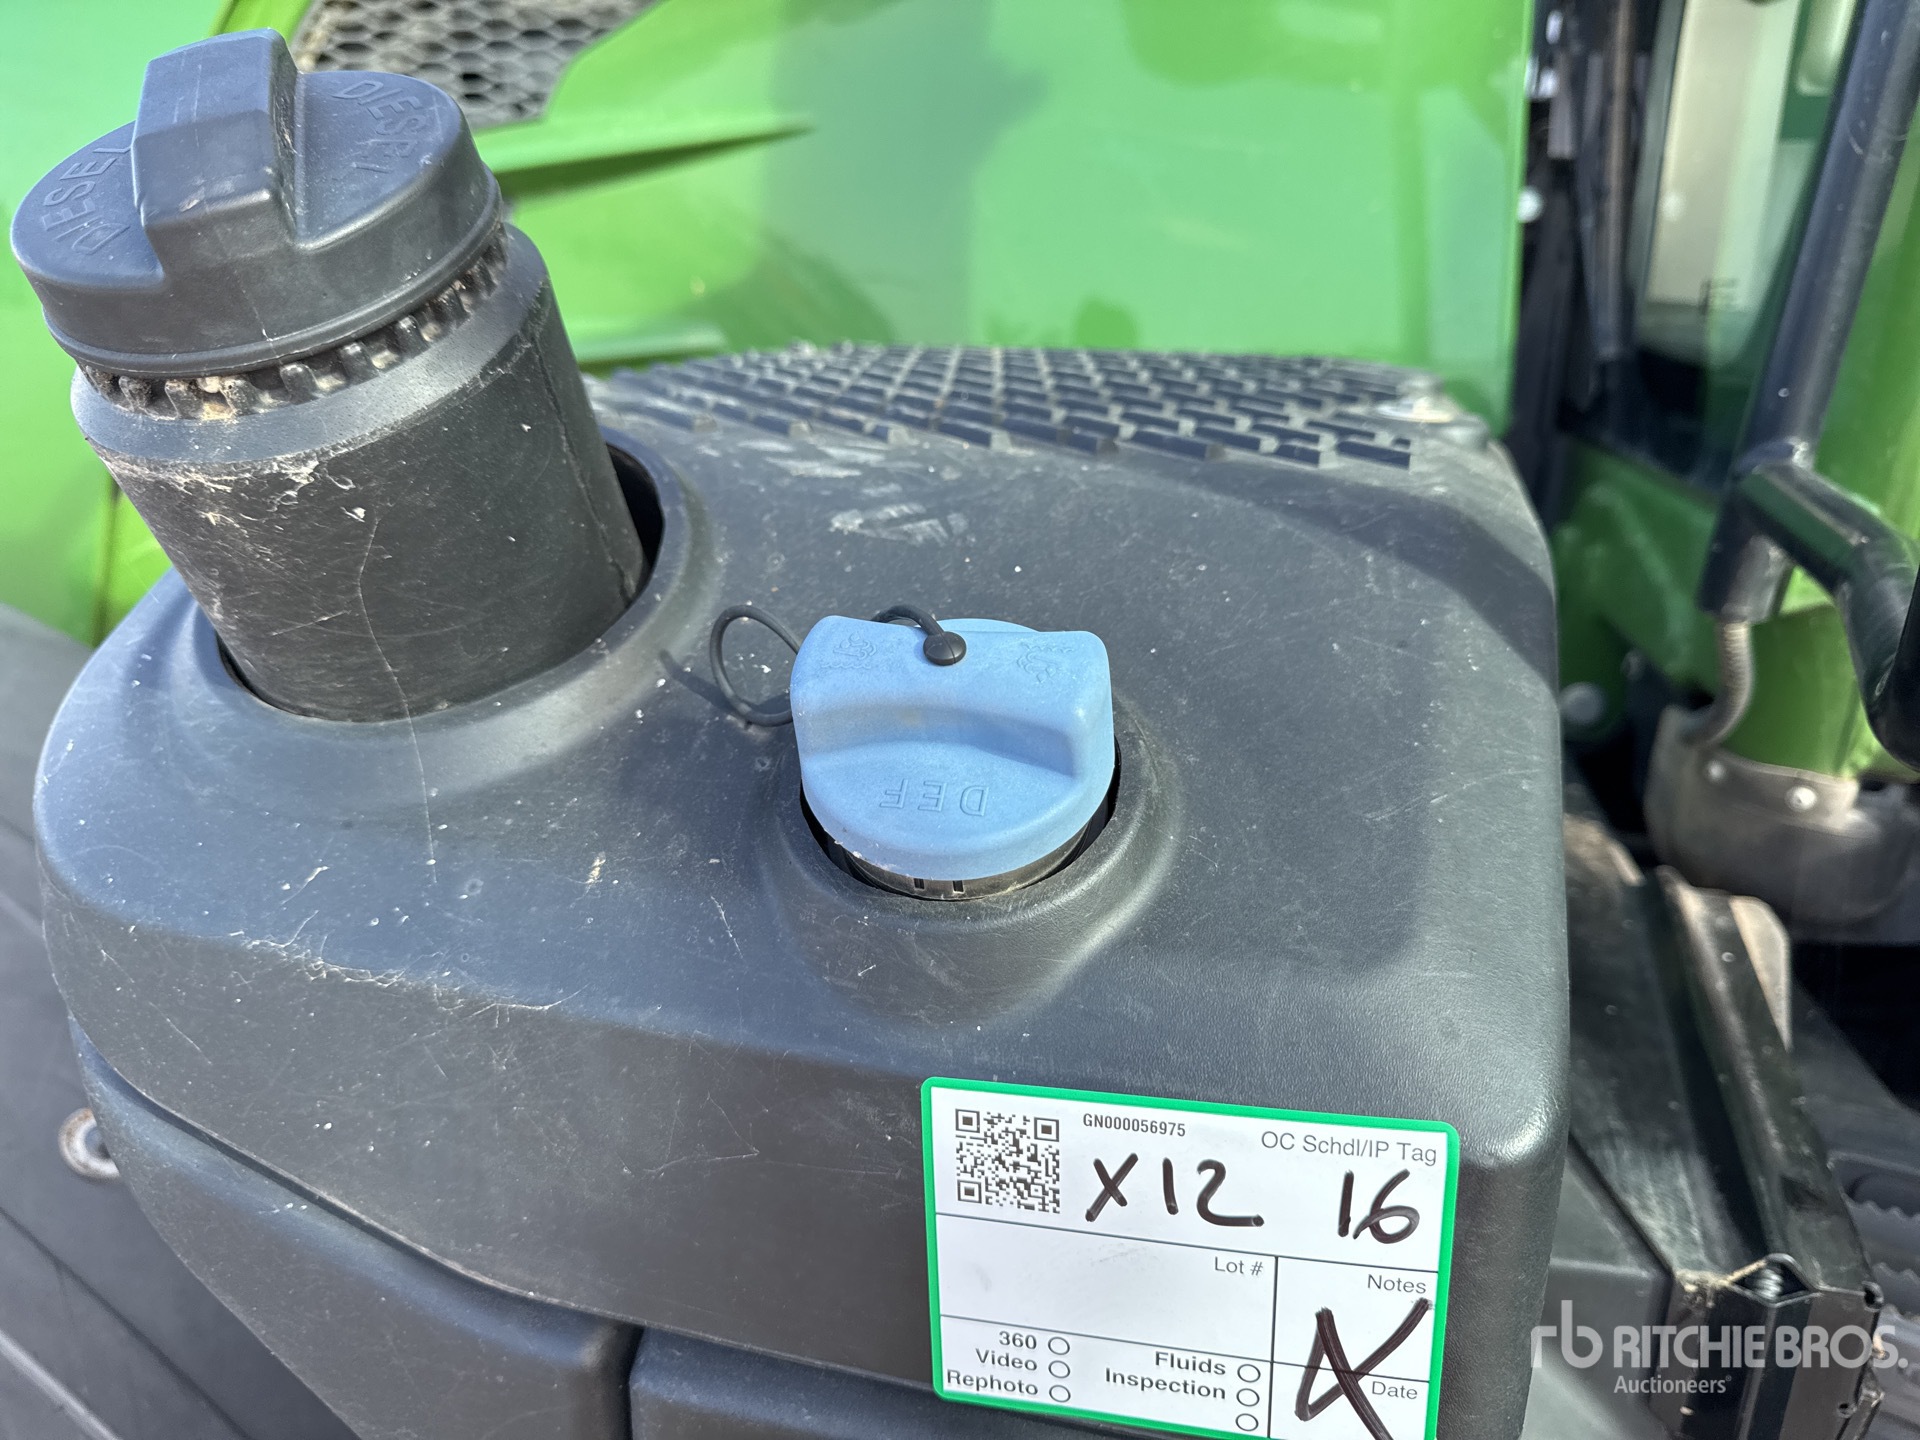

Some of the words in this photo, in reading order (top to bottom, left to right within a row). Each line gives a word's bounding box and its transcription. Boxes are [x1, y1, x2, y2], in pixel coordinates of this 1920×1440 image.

[880, 778, 990, 817] DEF
[1082, 1113, 1187, 1138] GN000056975
[1260, 1131, 1296, 1151] OC
[1301, 1135, 1391, 1160] Schdl/IP
[1396, 1142, 1438, 1167] Tag
[1214, 1257, 1245, 1275] Lot
[1249, 1261, 1265, 1276] #
[1366, 1274, 1428, 1295] Notes
[998, 1331, 1038, 1350] 360
[975, 1348, 1038, 1372] Video
[1154, 1350, 1227, 1376] Fluids
[946, 1369, 1039, 1397] Rephoto
[1104, 1367, 1227, 1401] Inspection
[1371, 1381, 1419, 1401] Date
